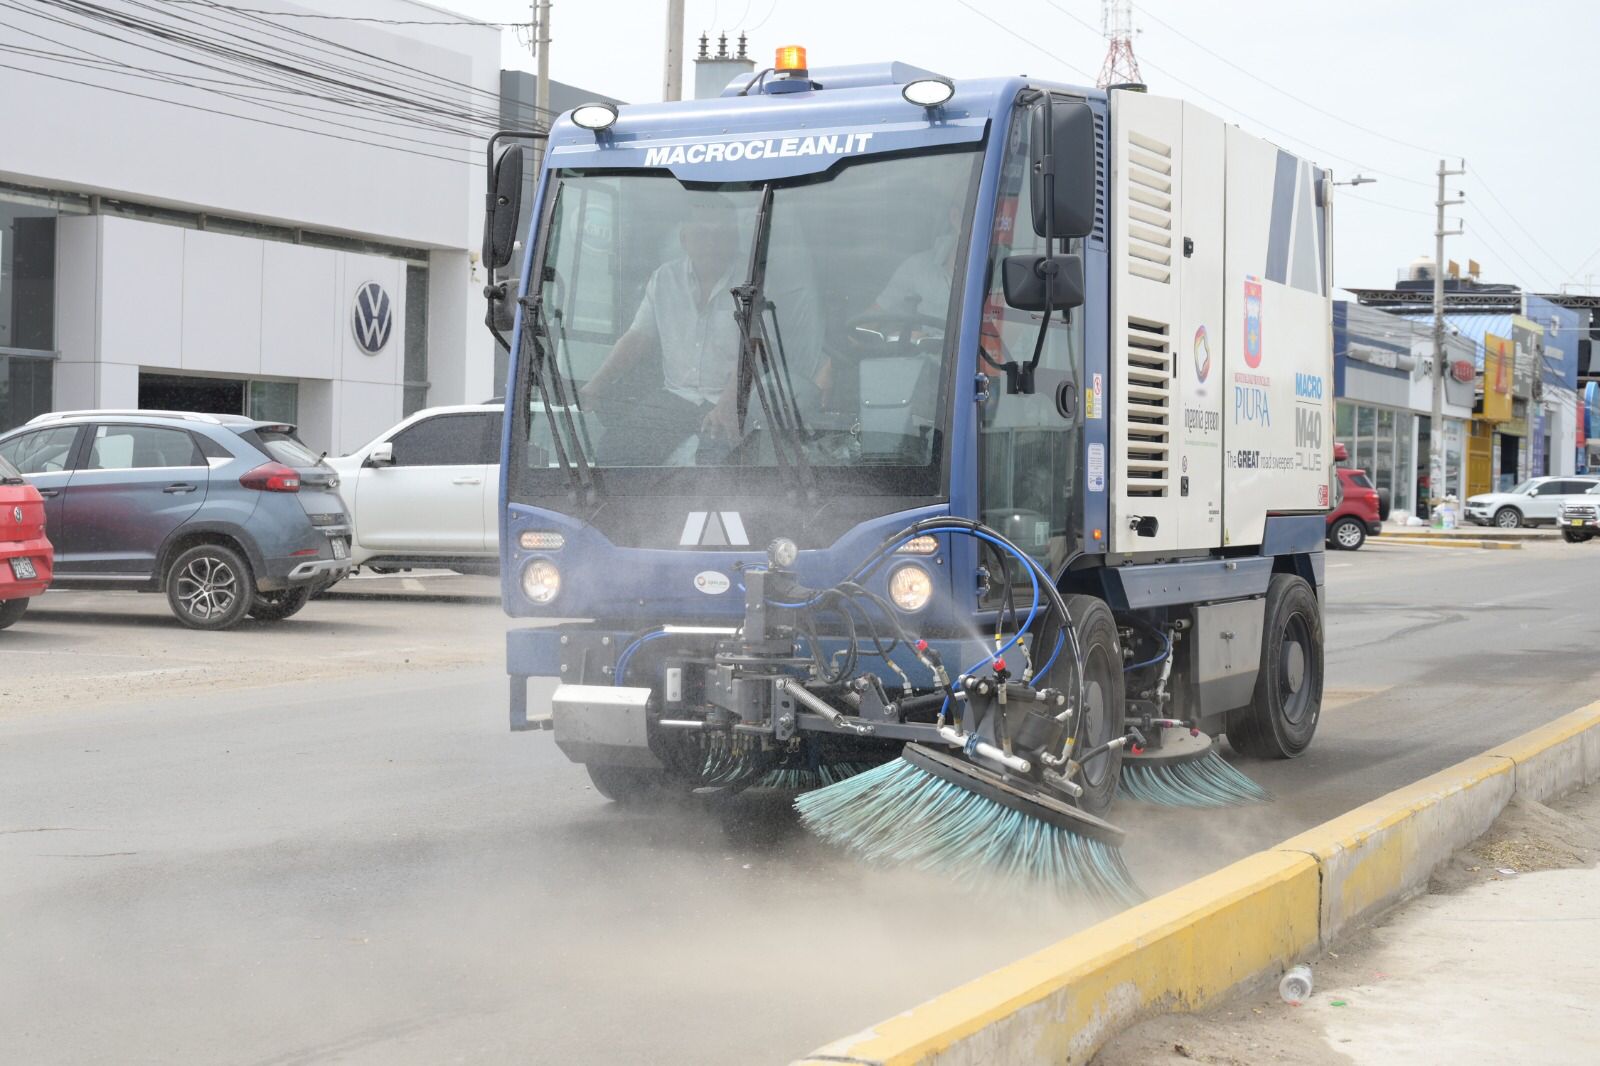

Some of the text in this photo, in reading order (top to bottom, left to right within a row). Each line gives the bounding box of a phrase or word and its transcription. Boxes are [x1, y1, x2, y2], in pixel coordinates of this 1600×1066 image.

[644, 133, 873, 167] MACROCLEAN.IT
[1295, 373, 1322, 400] MACRO
[1235, 386, 1270, 427] PIURA
[1204, 410, 1220, 435] green
[1295, 407, 1322, 450] M40
[1227, 450, 1294, 472] The GREAT road sweepers
